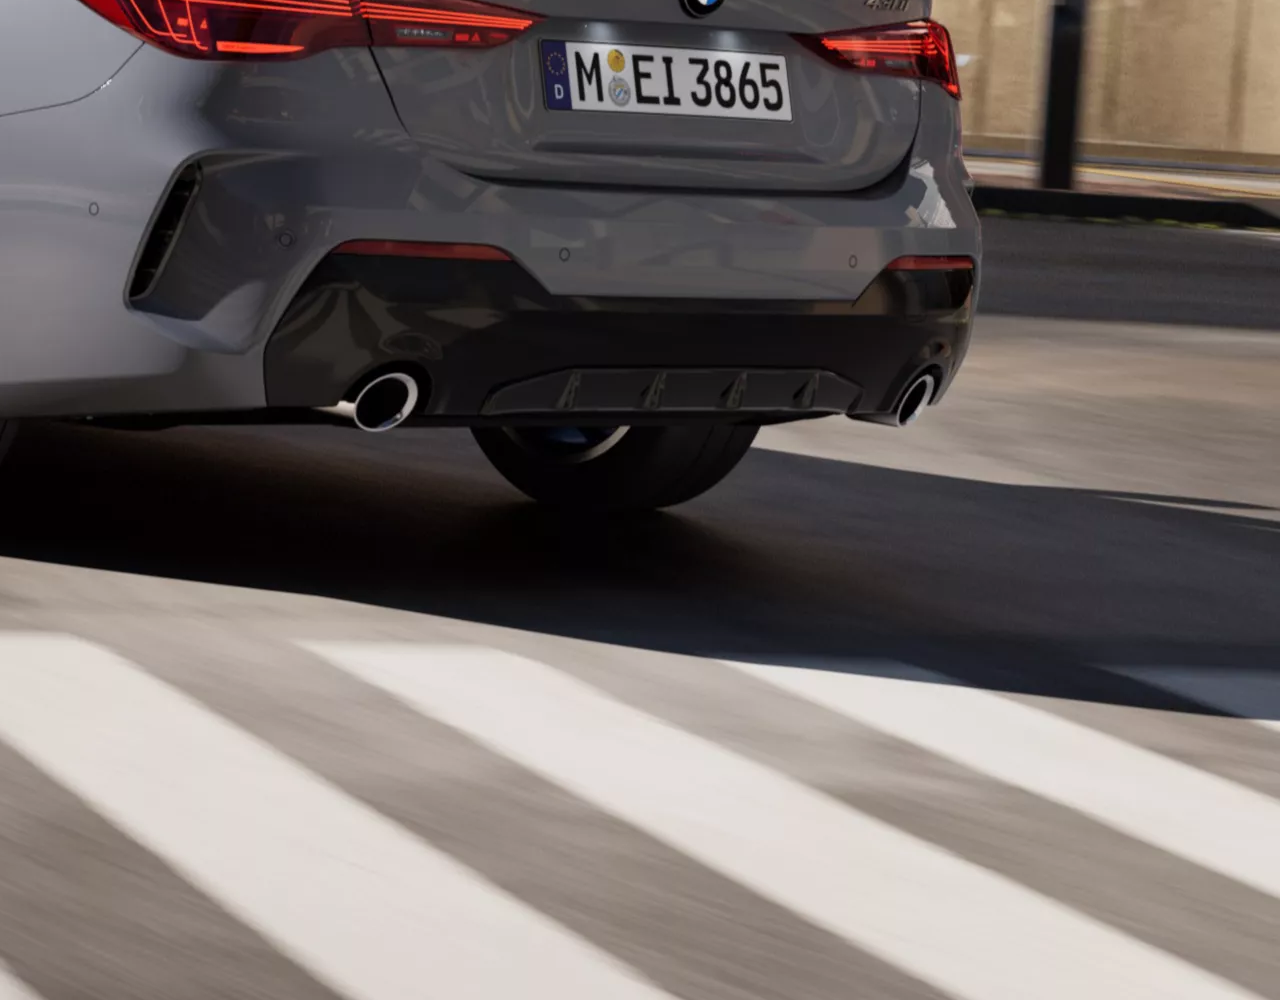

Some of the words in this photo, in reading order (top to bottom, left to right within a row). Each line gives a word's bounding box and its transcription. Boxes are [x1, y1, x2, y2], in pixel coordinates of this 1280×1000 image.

[554, 83, 564, 100] D
[575, 51, 604, 102] M
[632, 54, 681, 106] EI
[688, 57, 784, 112] 3865
